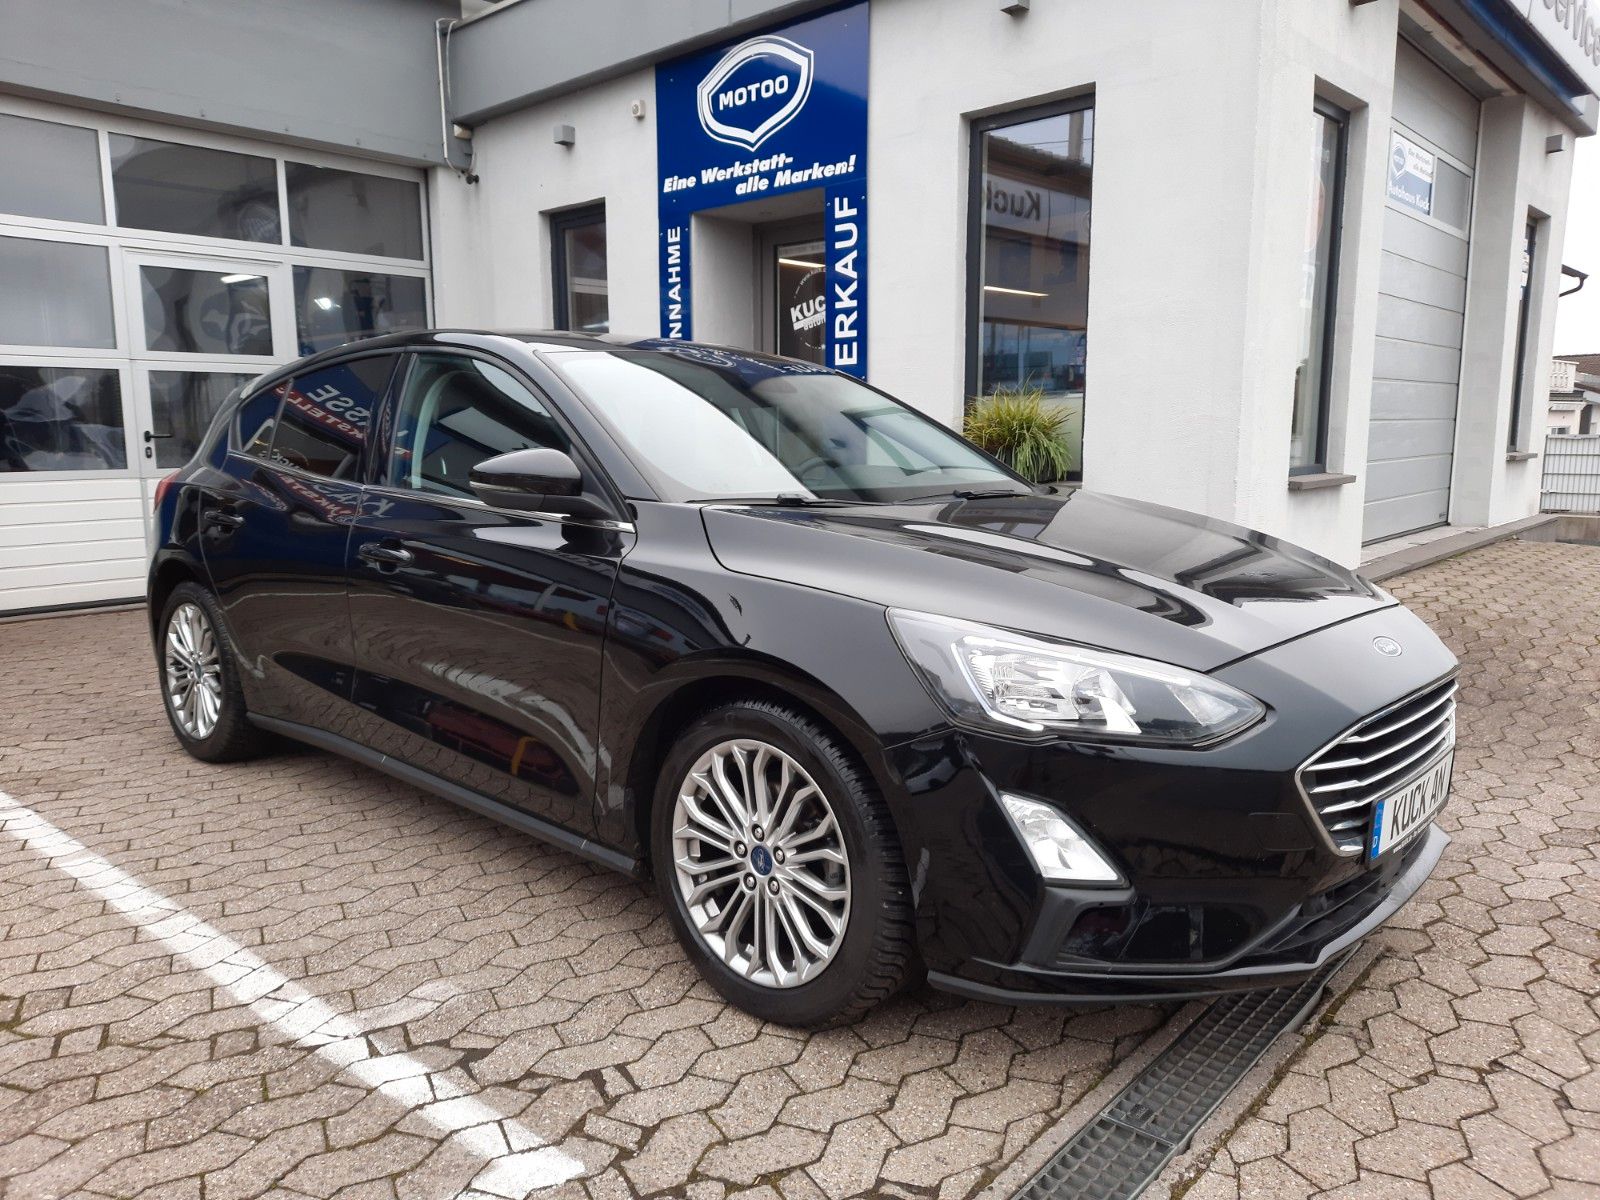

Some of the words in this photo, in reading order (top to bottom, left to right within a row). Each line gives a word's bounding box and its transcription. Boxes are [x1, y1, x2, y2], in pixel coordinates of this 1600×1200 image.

[1542, 0, 1600, 67] ervice
[719, 74, 789, 111] MOTOO
[663, 175, 697, 193] Eine
[701, 153, 794, 184] Werkstatt-
[735, 175, 769, 196] alle
[773, 154, 857, 188] Marken!
[667, 226, 682, 338] NNAHME
[834, 196, 858, 366] ERKAUF
[790, 295, 826, 322] KUC
[1390, 775, 1431, 841] KUCK
[1429, 762, 1447, 808] AN
